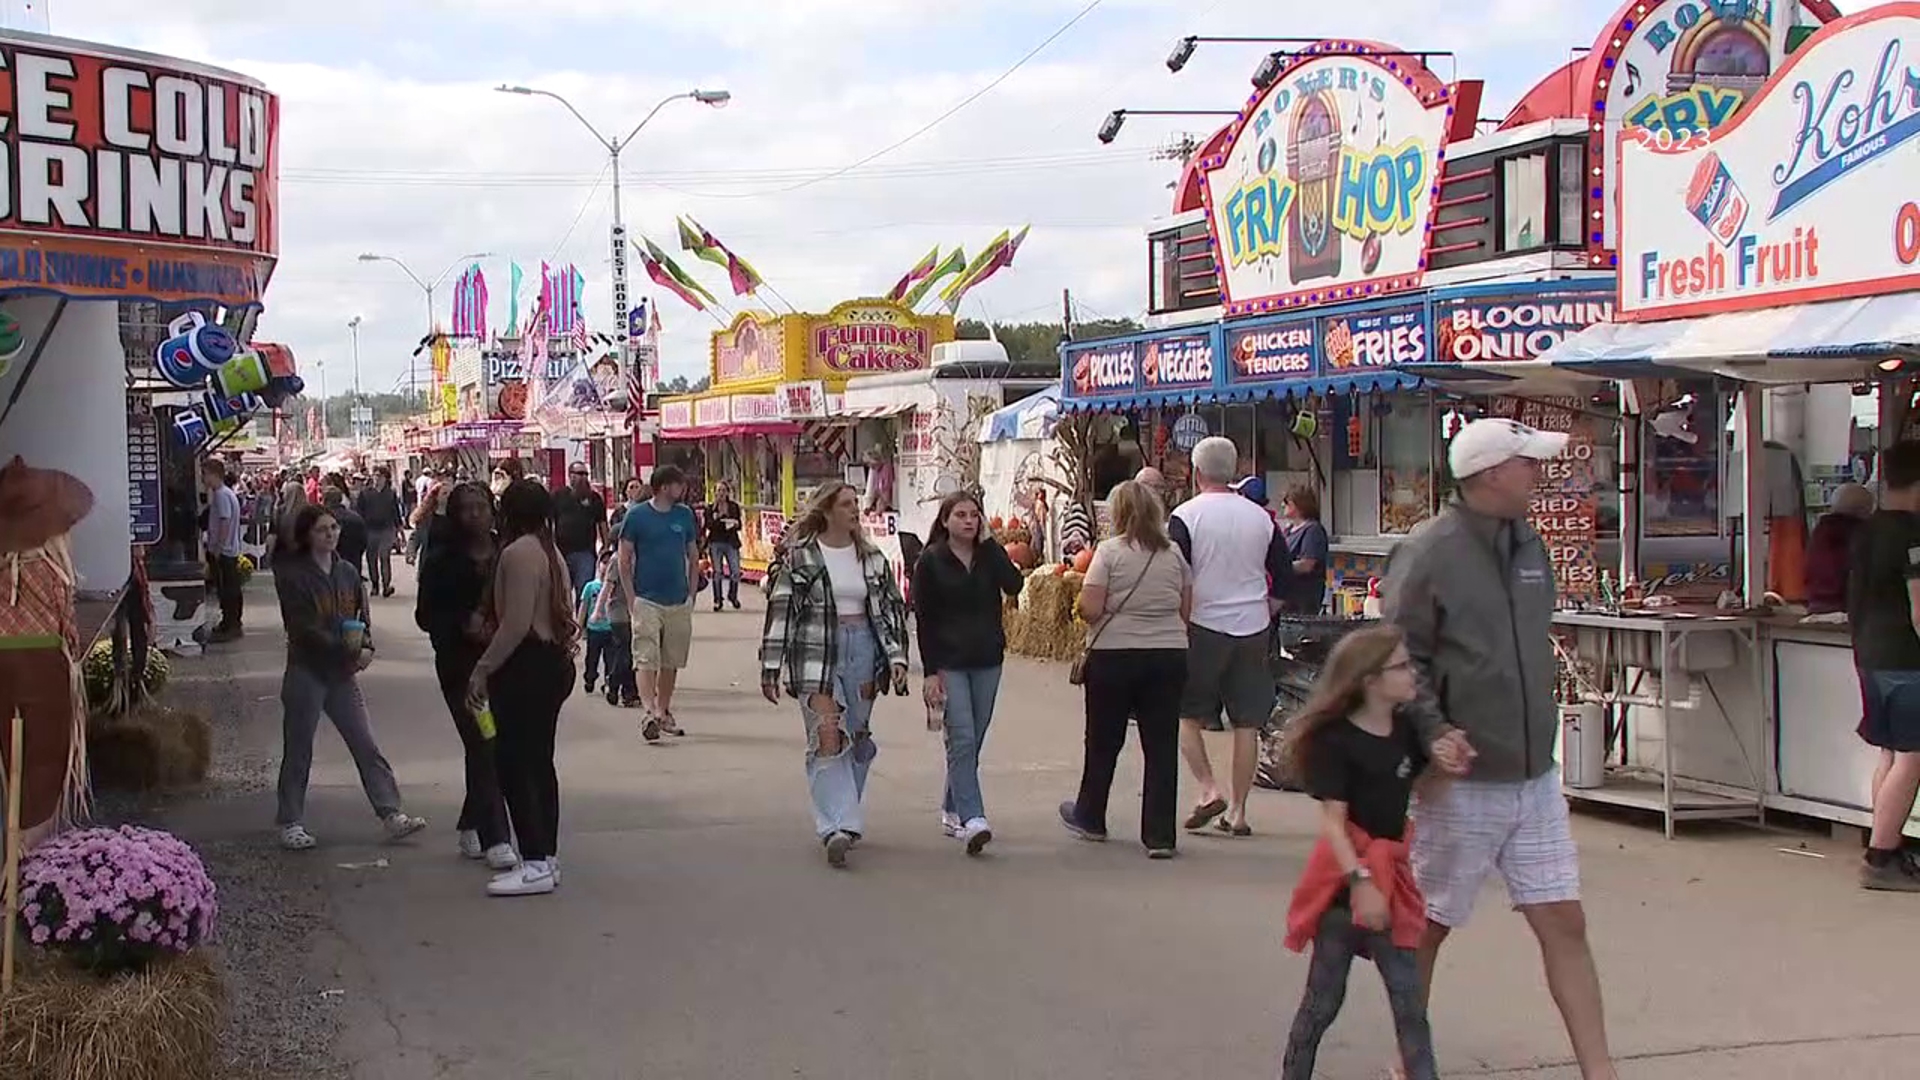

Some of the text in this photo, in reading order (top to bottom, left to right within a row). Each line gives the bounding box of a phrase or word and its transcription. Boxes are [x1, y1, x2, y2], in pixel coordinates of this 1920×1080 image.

[0, 50, 265, 169] E COLD
[1627, 87, 1740, 139] FRY
[1840, 134, 1887, 168] FAMOUS
[1224, 141, 1425, 263] FRY HOP
[1641, 225, 1819, 300] Fresh Fruit
[613, 239, 627, 330] REST ROOMS
[1452, 301, 1613, 332] BLOOMIN
[817, 324, 927, 355] Funnel
[1242, 328, 1312, 353] CHICKEN
[1350, 326, 1425, 367] FRIES
[825, 344, 922, 371] Cakes
[1090, 350, 1135, 387] PICKLES
[1158, 347, 1212, 383] VEGGIES
[1245, 352, 1310, 375] TENDERS
[1542, 413, 1573, 430] FRIES
[1527, 499, 1579, 514] RIED
